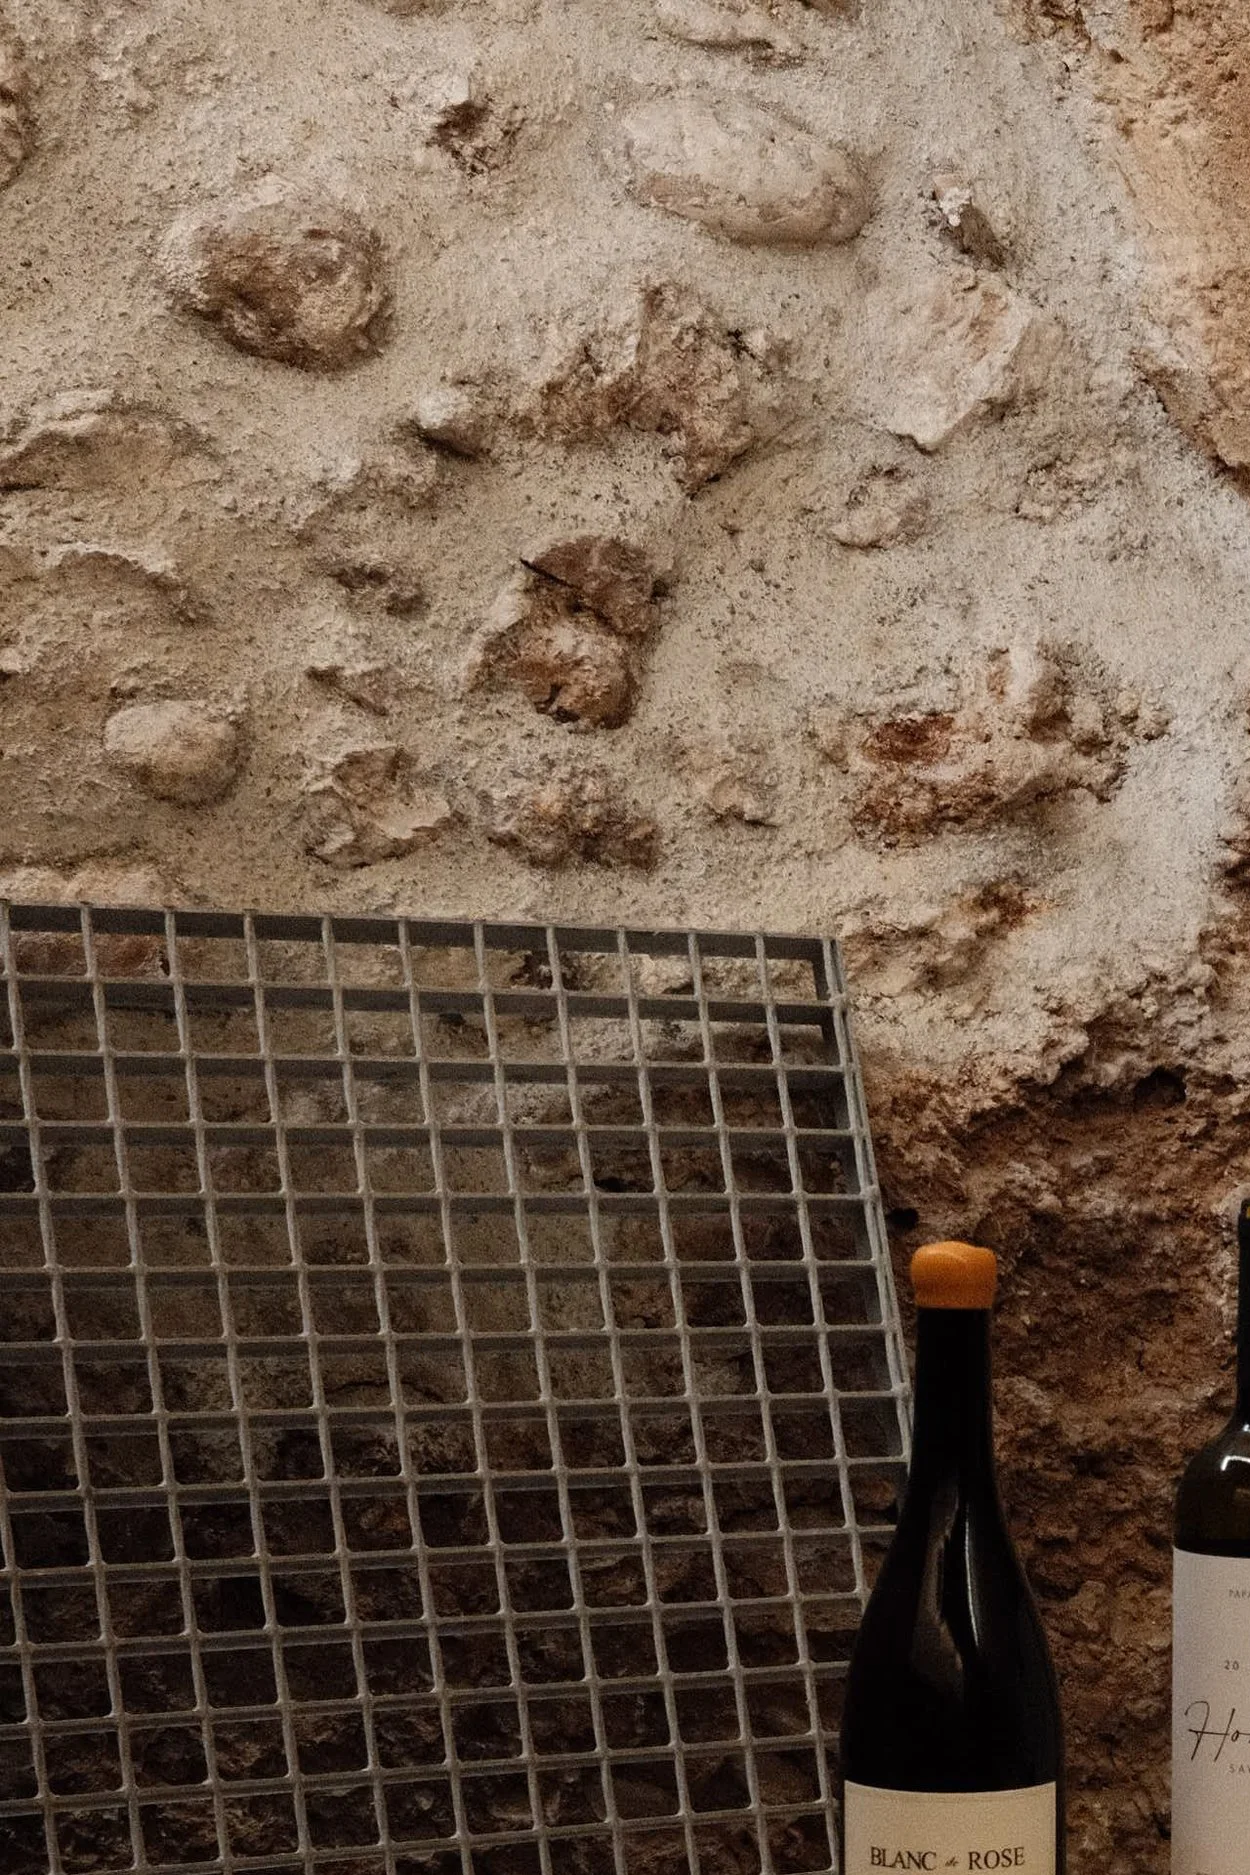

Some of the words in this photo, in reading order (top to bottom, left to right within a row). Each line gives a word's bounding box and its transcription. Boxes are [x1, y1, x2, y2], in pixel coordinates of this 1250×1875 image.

[1223, 1659, 1240, 1672] 20
[869, 1845, 937, 1872] BLANC
[967, 1846, 1027, 1871] ROSE
